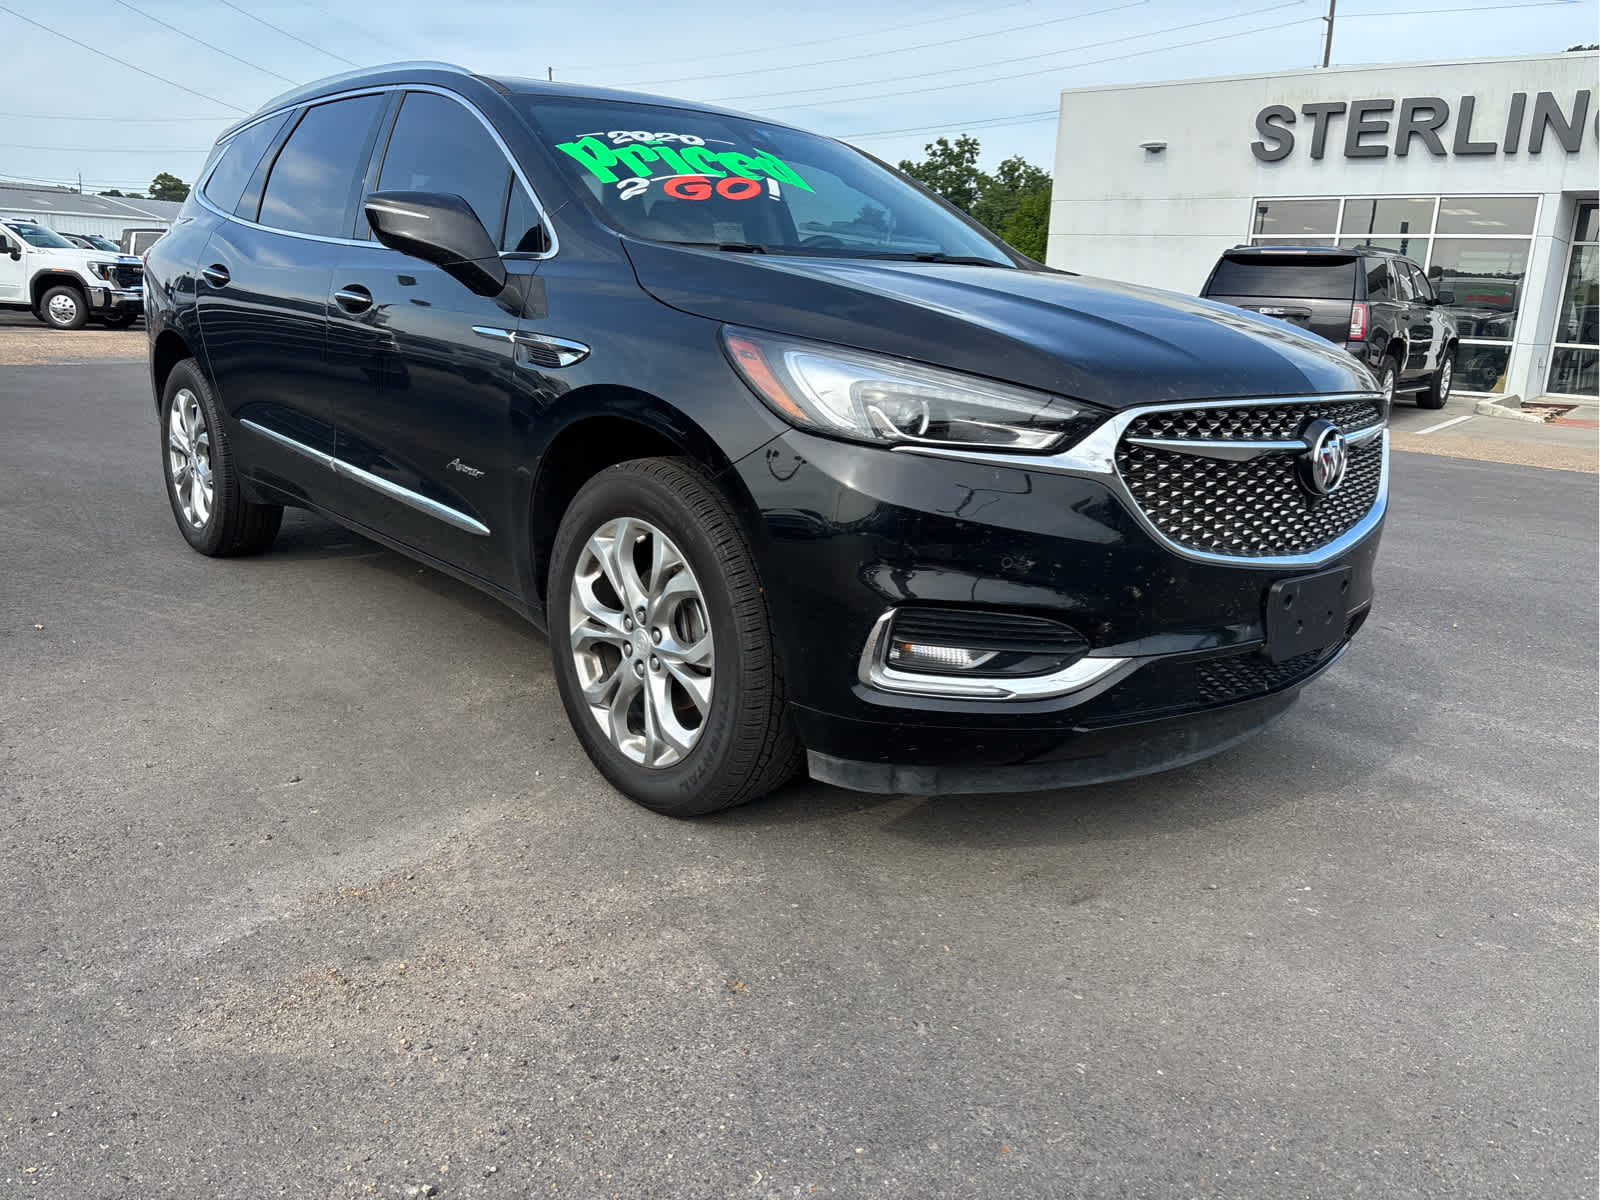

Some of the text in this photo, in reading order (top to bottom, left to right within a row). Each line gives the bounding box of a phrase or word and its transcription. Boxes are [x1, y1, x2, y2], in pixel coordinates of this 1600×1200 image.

[607, 130, 706, 146] 2020
[1250, 89, 1599, 161] STERLIN
[554, 136, 816, 193] Priced
[616, 177, 650, 200] 2
